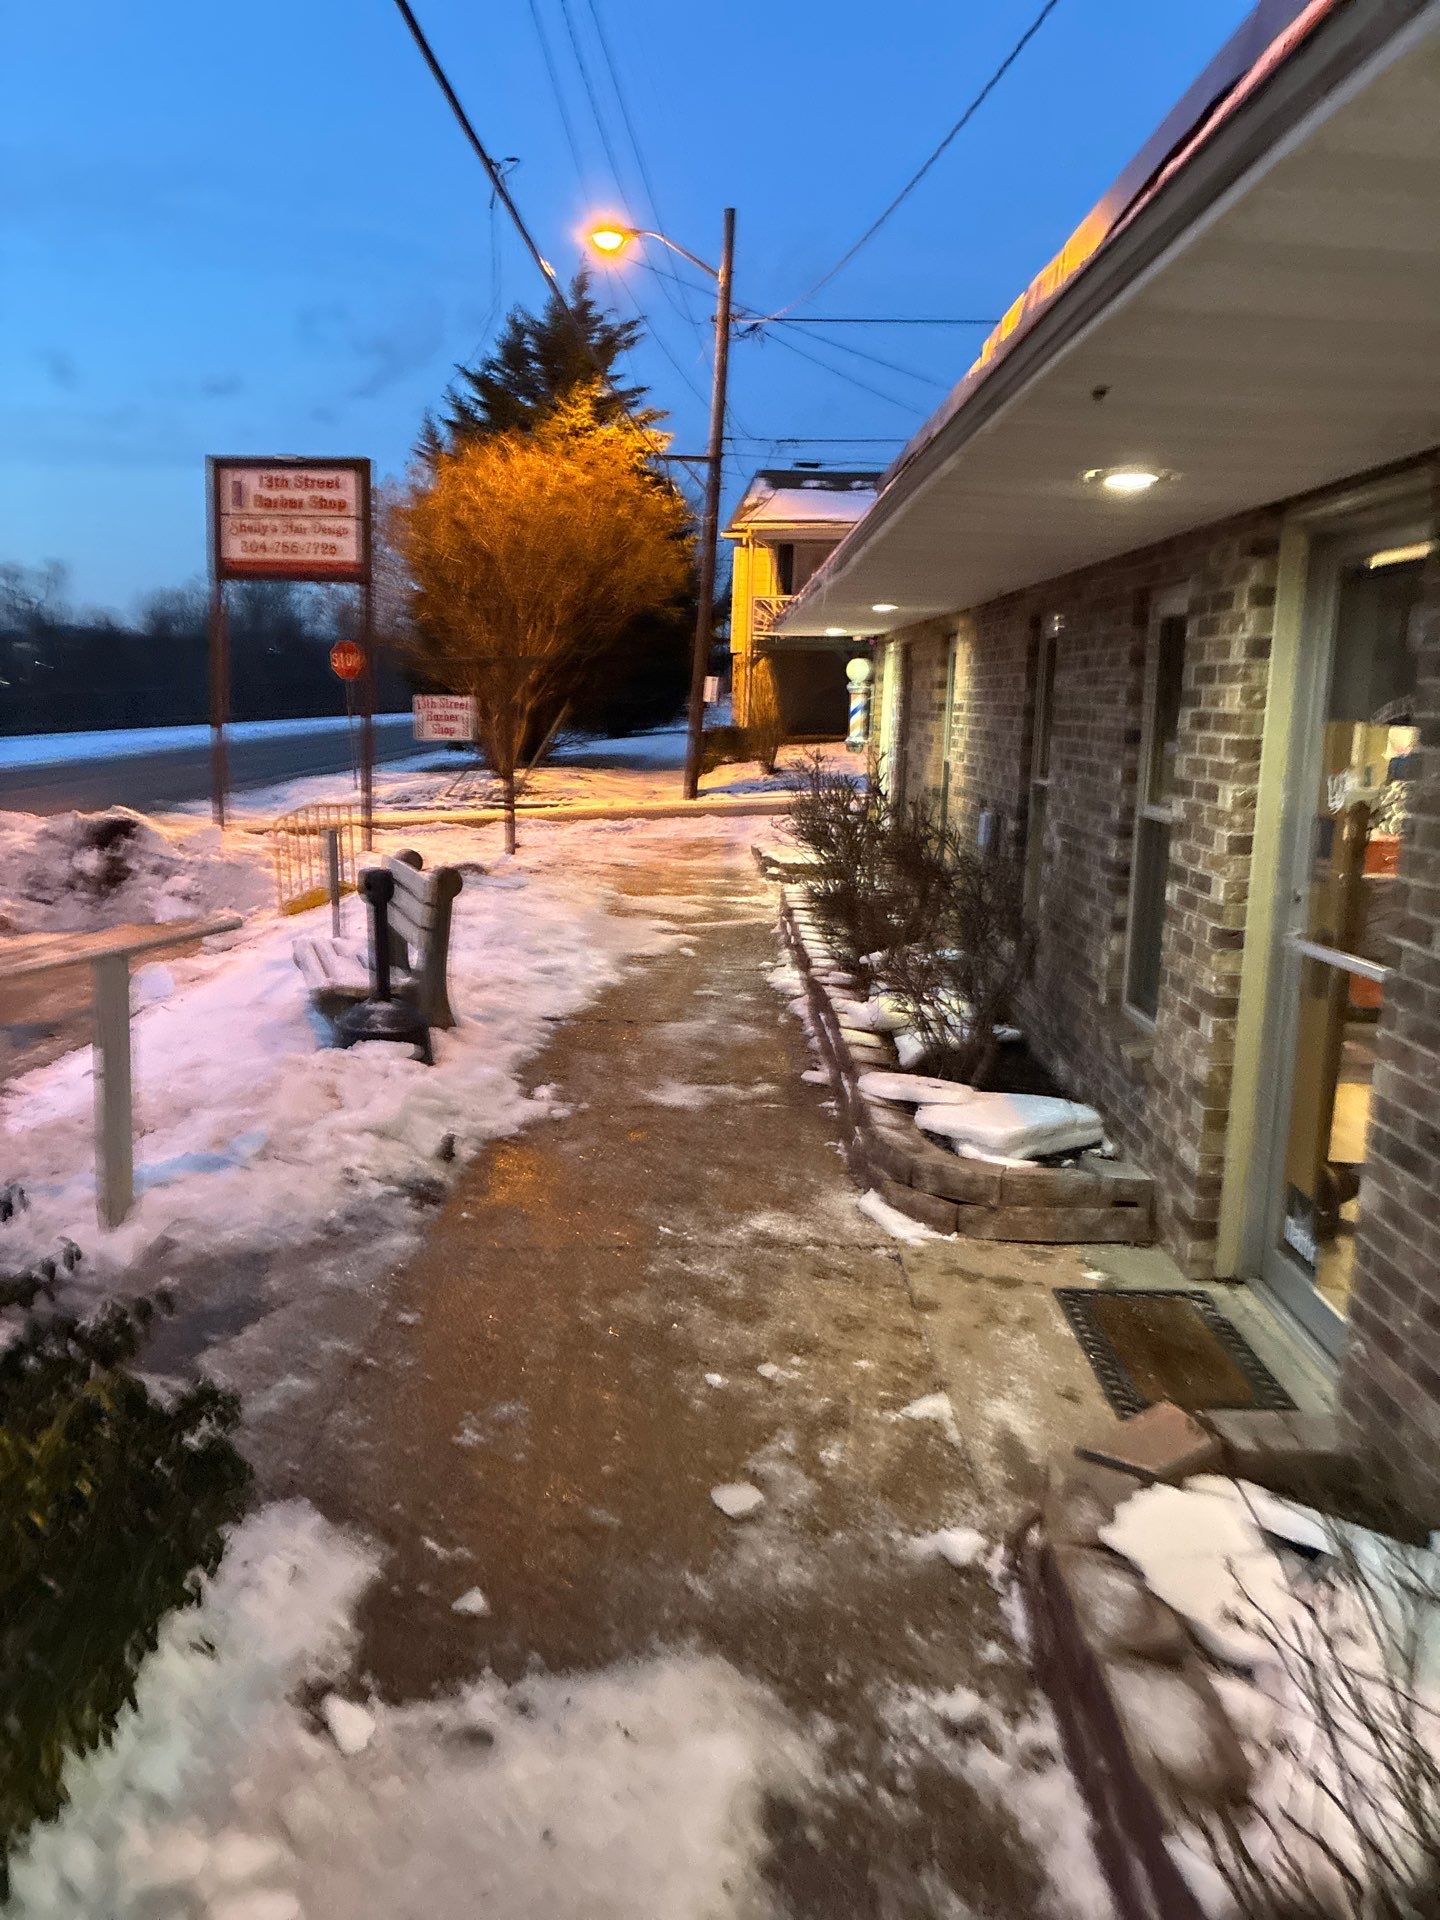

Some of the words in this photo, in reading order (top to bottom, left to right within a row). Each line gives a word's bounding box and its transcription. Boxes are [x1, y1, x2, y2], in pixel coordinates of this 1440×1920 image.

[259, 475, 289, 491] 13th
[294, 475, 340, 491] Street
[255, 495, 304, 509] Barber
[308, 496, 347, 512] Shop
[312, 522, 349, 538] Design
[417, 698, 437, 710] 13th
[440, 698, 469, 711] Street
[432, 723, 455, 737] Shop
